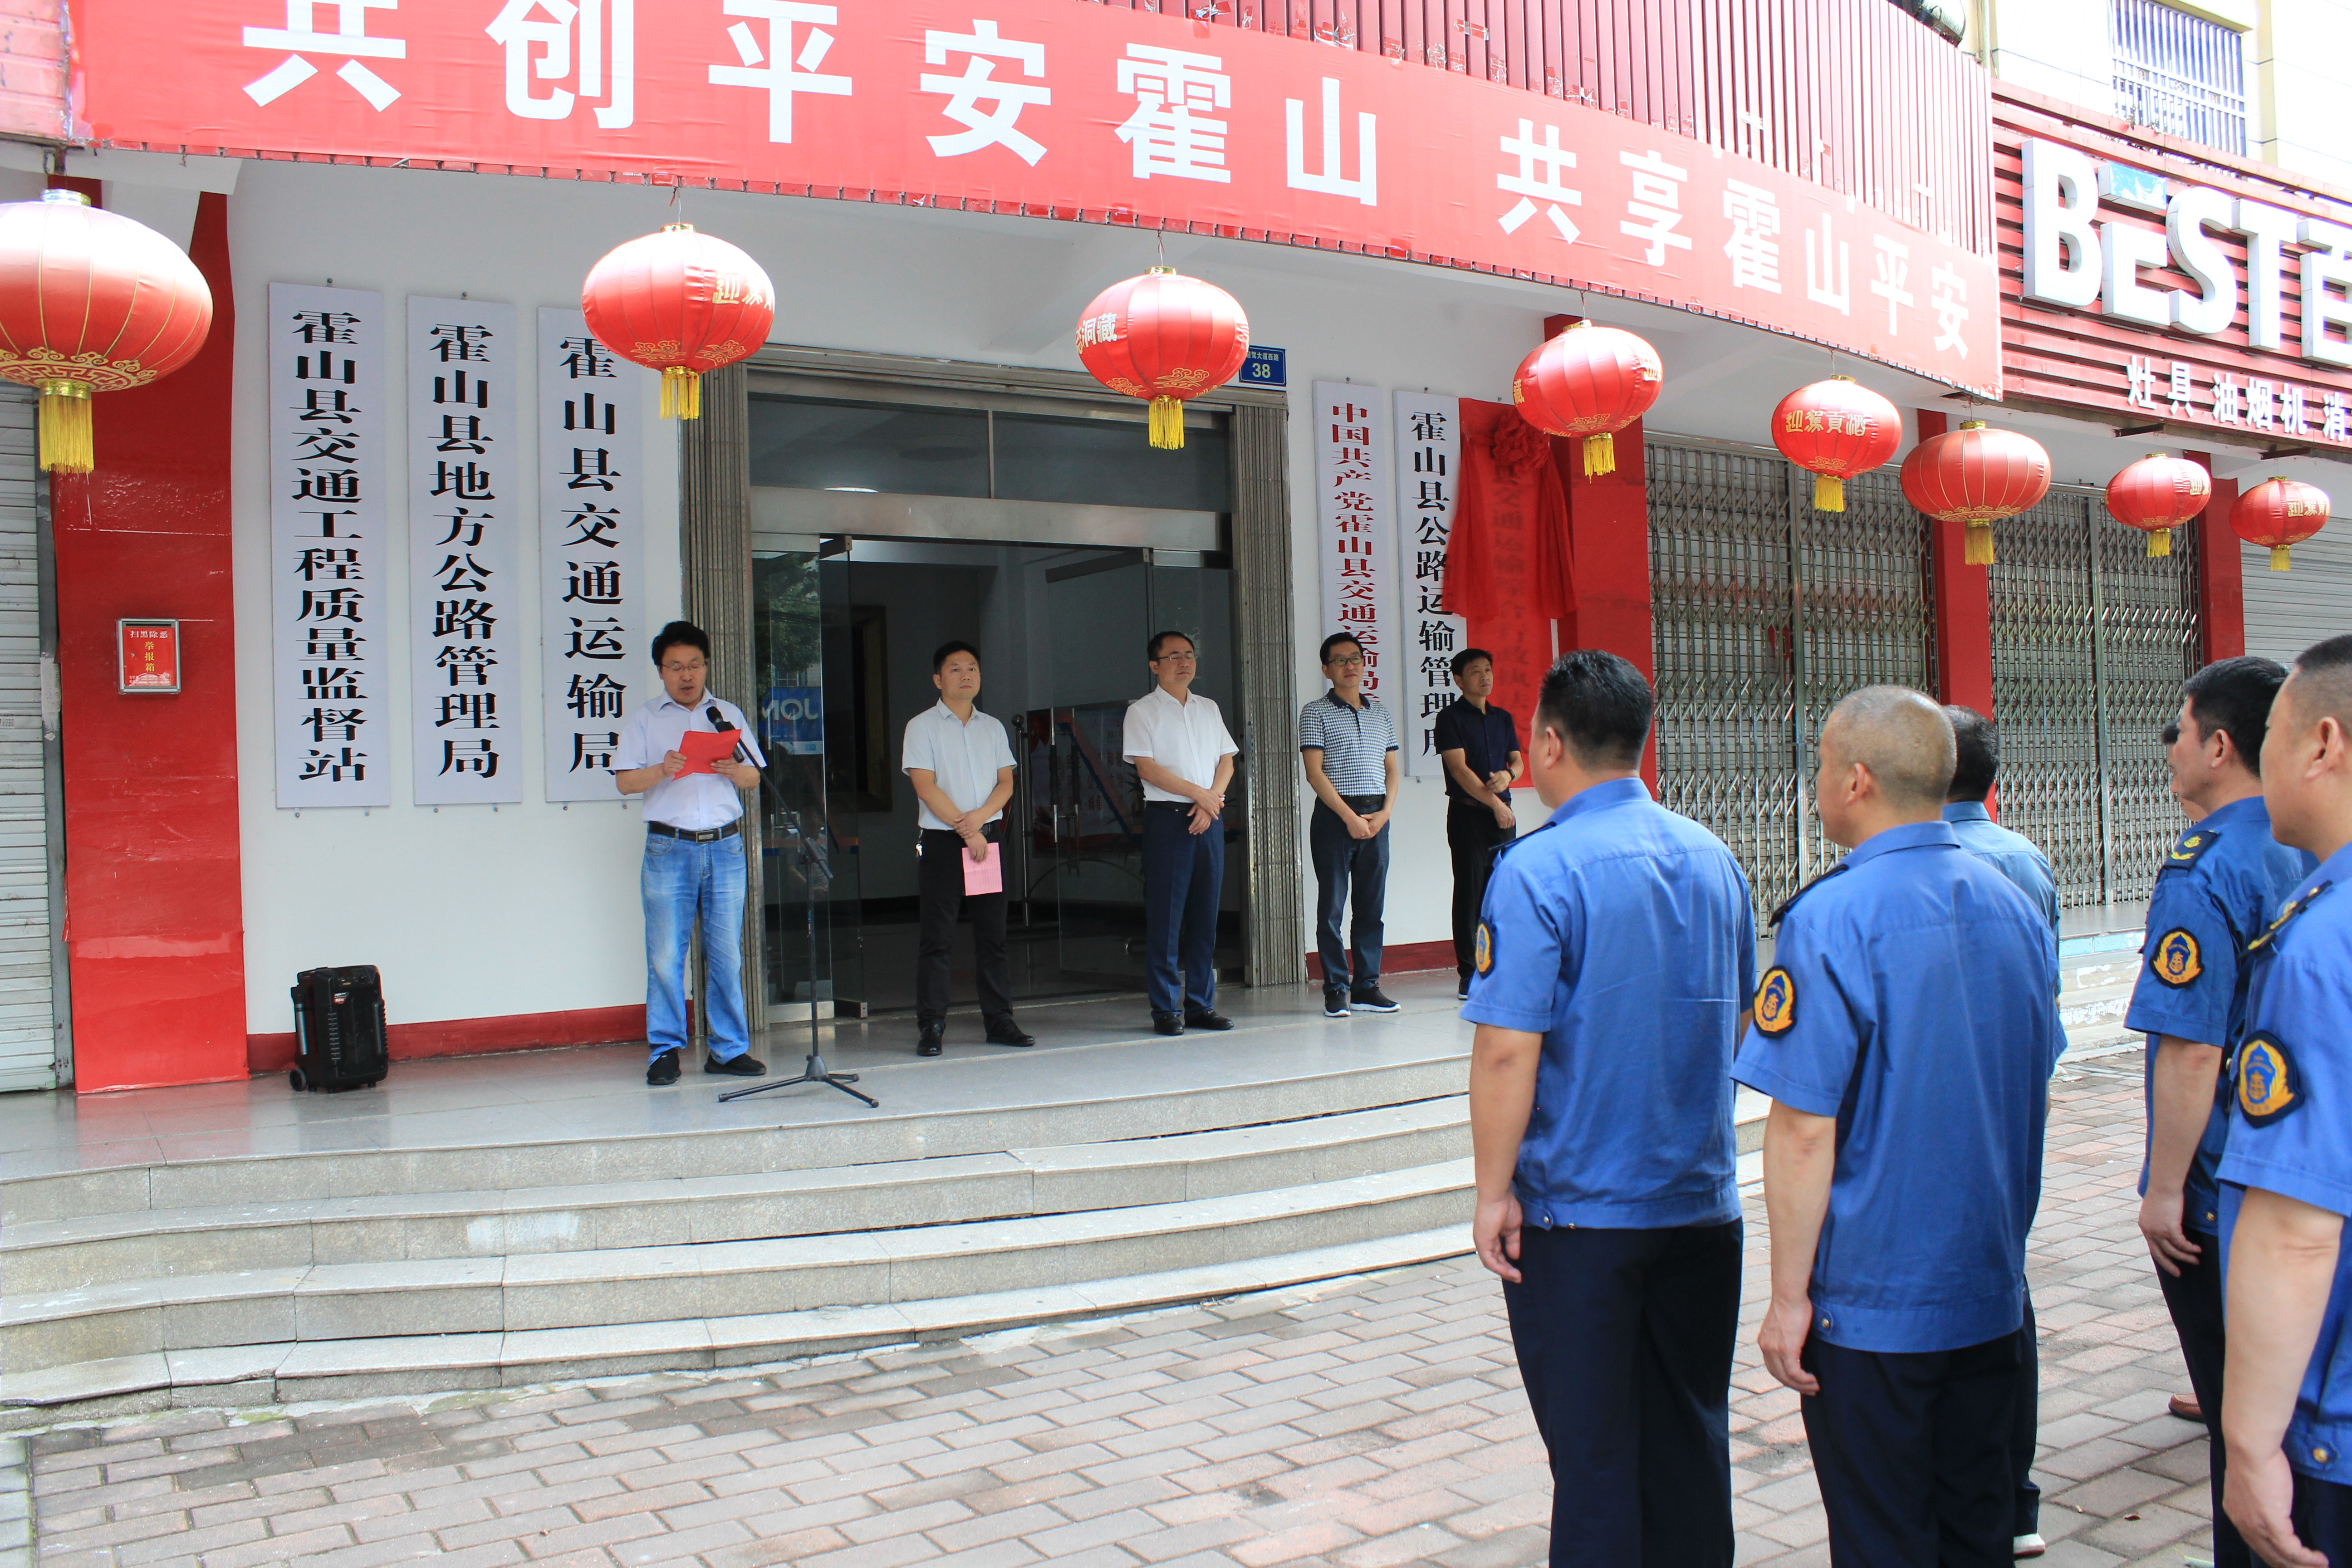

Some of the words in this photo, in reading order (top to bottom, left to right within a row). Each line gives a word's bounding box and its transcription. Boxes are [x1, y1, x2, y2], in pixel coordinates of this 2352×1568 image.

[242, 0, 1377, 207] 共创平安霍山
[1497, 118, 1970, 361] 共享霍山平安
[1252, 363, 1271, 378] 38
[130, 630, 168, 639] 扫黑除恶
[144, 641, 155, 672] 举报箱
[289, 310, 368, 782] 霍山县交通工程质量监督站
[427, 323, 501, 779] 霍山县地方公路管理局
[559, 337, 627, 775] 霍山县交通运输局
[1331, 403, 1381, 703] 中国共产党霍山县交通运
